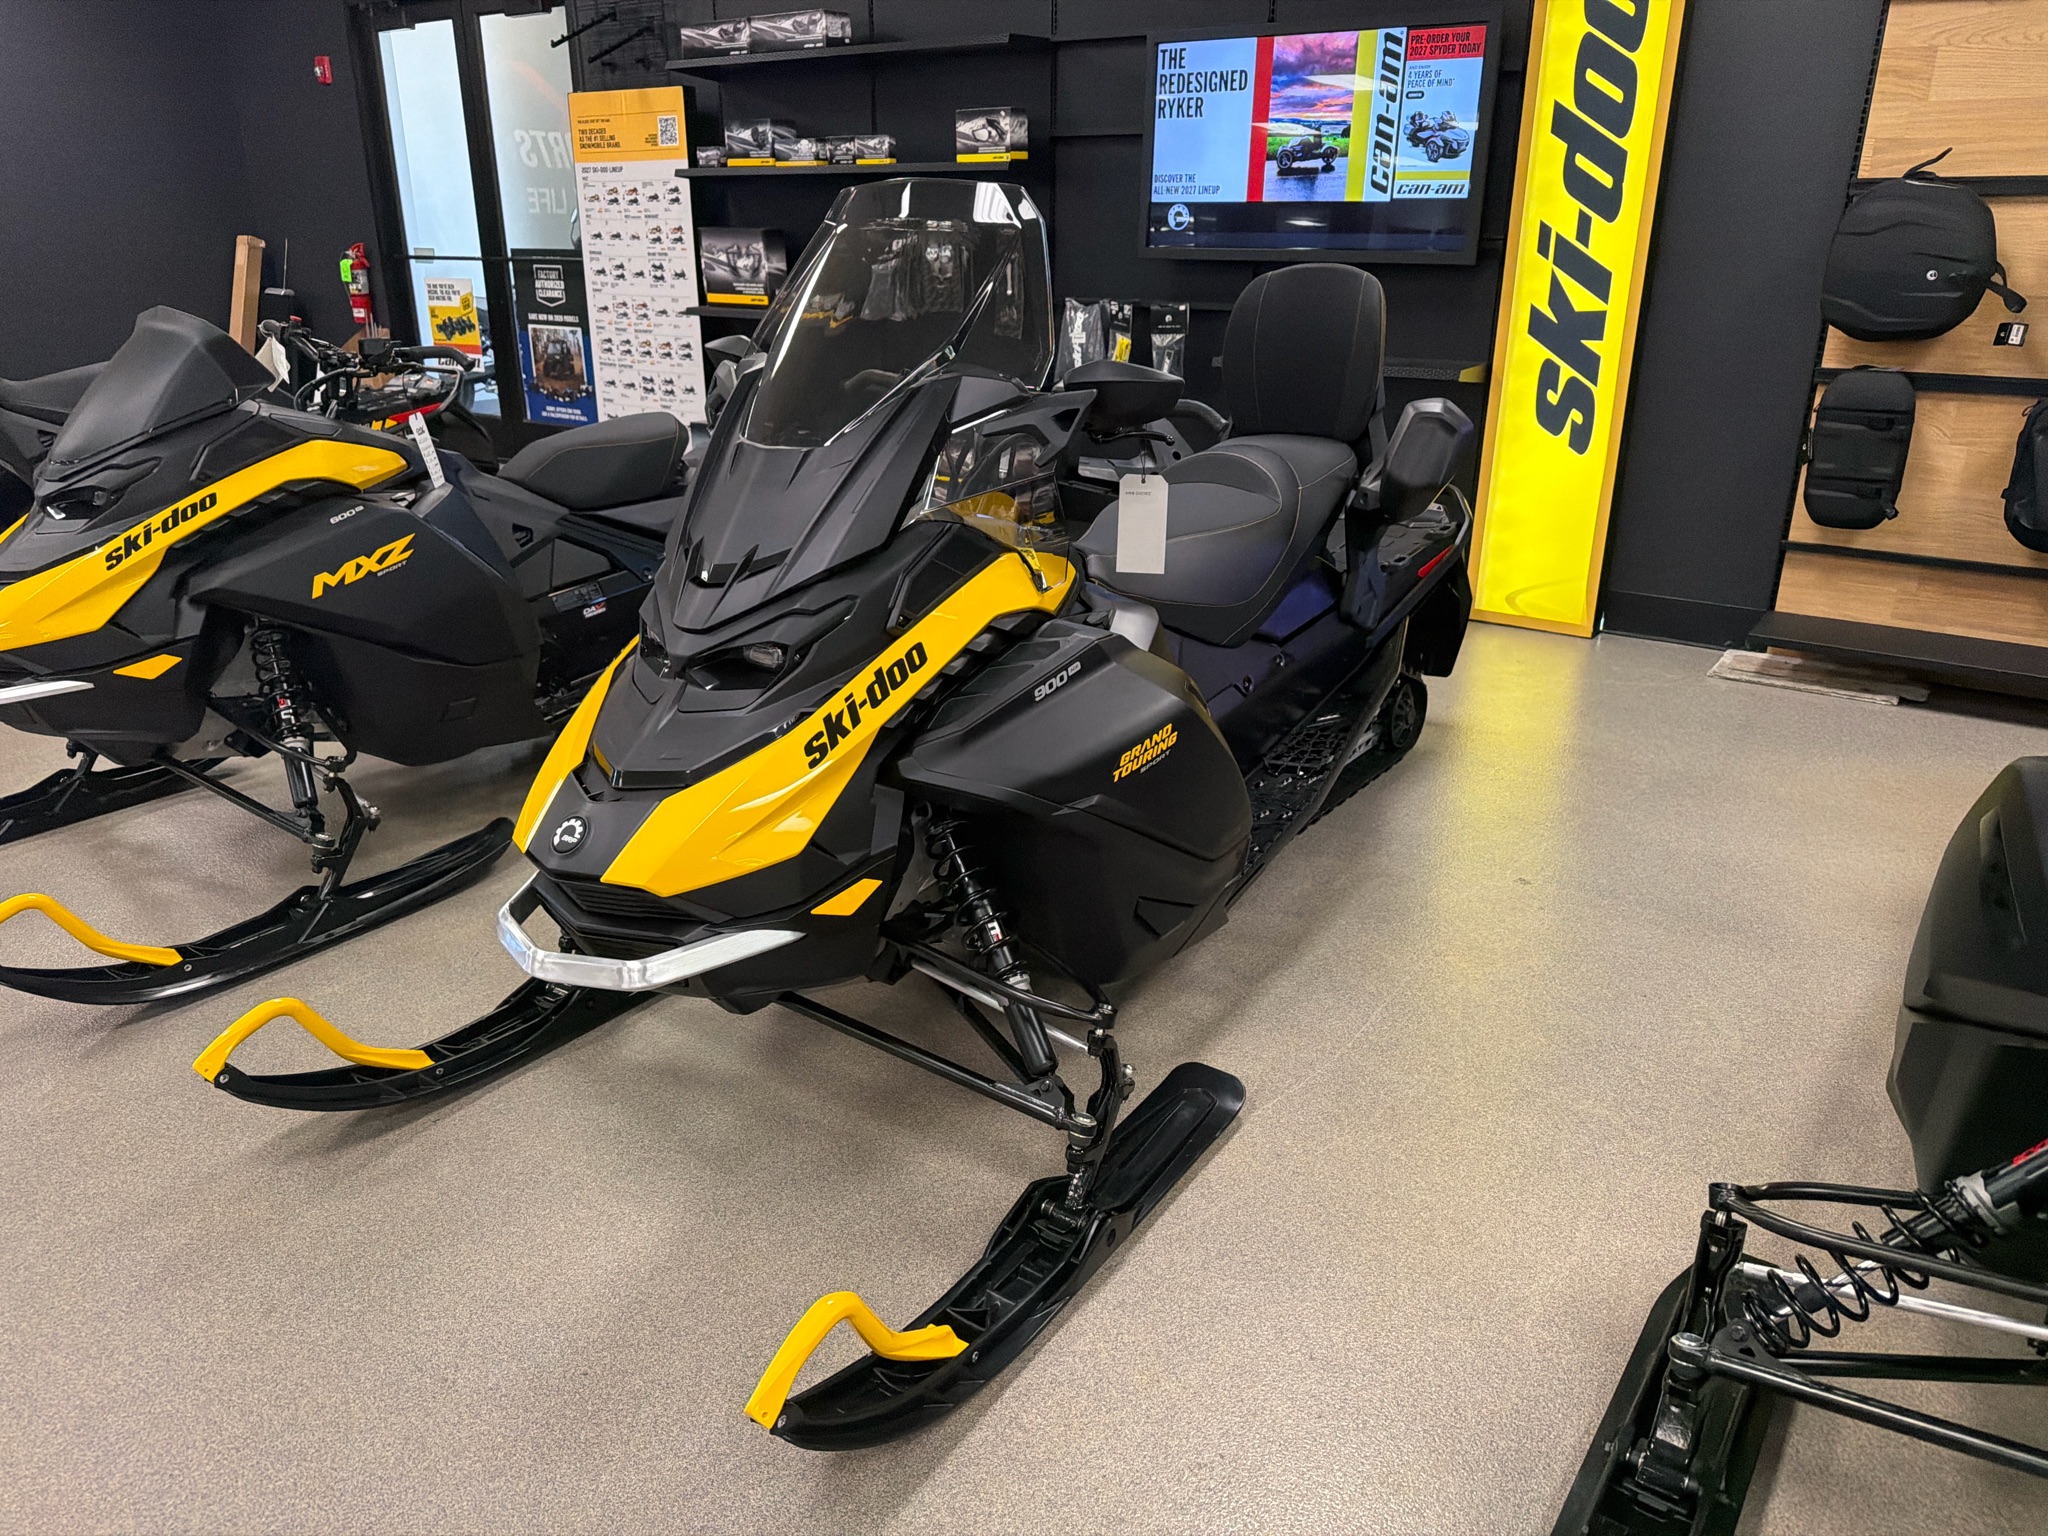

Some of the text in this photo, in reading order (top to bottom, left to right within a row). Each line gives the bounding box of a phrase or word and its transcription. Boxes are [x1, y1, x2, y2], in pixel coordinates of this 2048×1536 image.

[1410, 42, 1482, 57] 2027 SPYDER TODAY
[1411, 31, 1471, 46] PRE-ORDER YOUR
[1160, 47, 1187, 70] THE
[1159, 69, 1248, 95] REDESIGNED
[1407, 79, 1426, 89] PEACE
[1427, 79, 1436, 88] OF
[1413, 70, 1433, 80] YEARS
[1434, 69, 1443, 79] OF
[1158, 97, 1204, 120] RYKER
[1371, 31, 1404, 195] can-am
[1154, 173, 1197, 184] DISCOVER THE
[1154, 184, 1221, 195] ALL-NEW 2027 LINEUP
[1397, 181, 1467, 196] can-am
[537, 269, 559, 280] FACTORY
[105, 492, 218, 571] ski-doo
[311, 532, 416, 600] MXZ
[377, 560, 408, 577] SPORT
[1034, 670, 1068, 702] 900
[803, 640, 929, 770] ski-doo
[1120, 722, 1173, 767] GRAND
[1112, 730, 1179, 783] TOURING
[1140, 748, 1171, 774] SPORT
